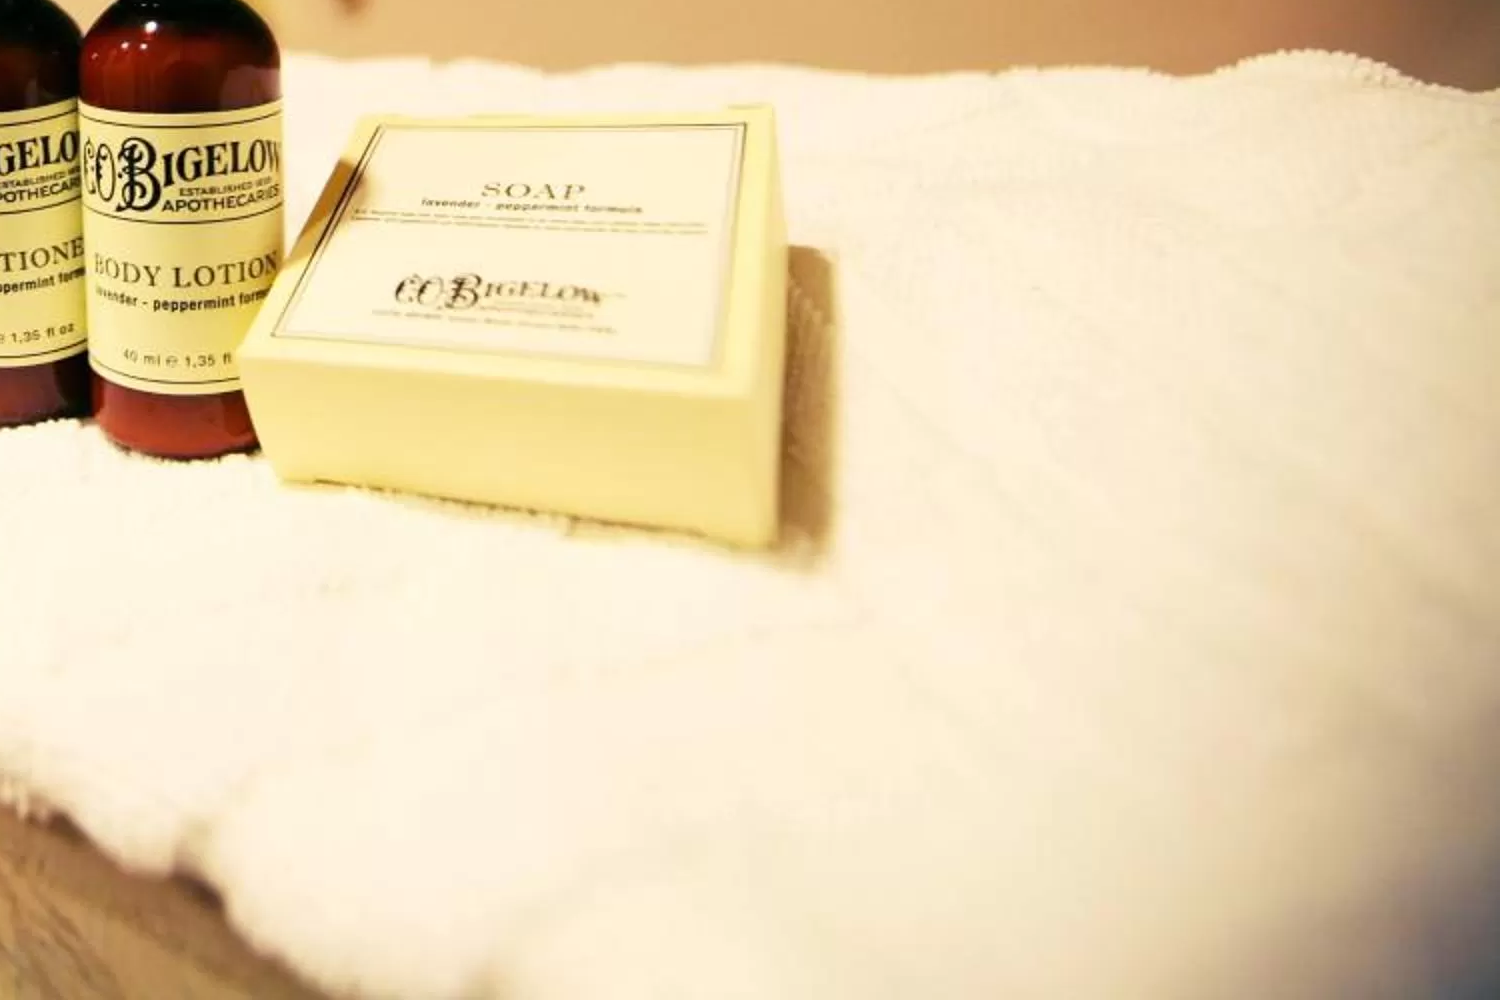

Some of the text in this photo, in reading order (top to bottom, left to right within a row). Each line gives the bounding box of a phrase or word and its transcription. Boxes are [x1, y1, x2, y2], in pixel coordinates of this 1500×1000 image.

[115, 136, 280, 213] BIGELOW
[161, 184, 281, 213] APOTHECARIES
[179, 181, 254, 198] ESTABLISHED
[480, 182, 586, 201] SOAP
[420, 197, 481, 209] lavender
[58, 266, 86, 283] form
[95, 251, 278, 289] BODY LOTION
[153, 295, 236, 312] peppermint
[239, 286, 272, 305] form
[59, 323, 75, 335] oz
[143, 354, 161, 366] ml
